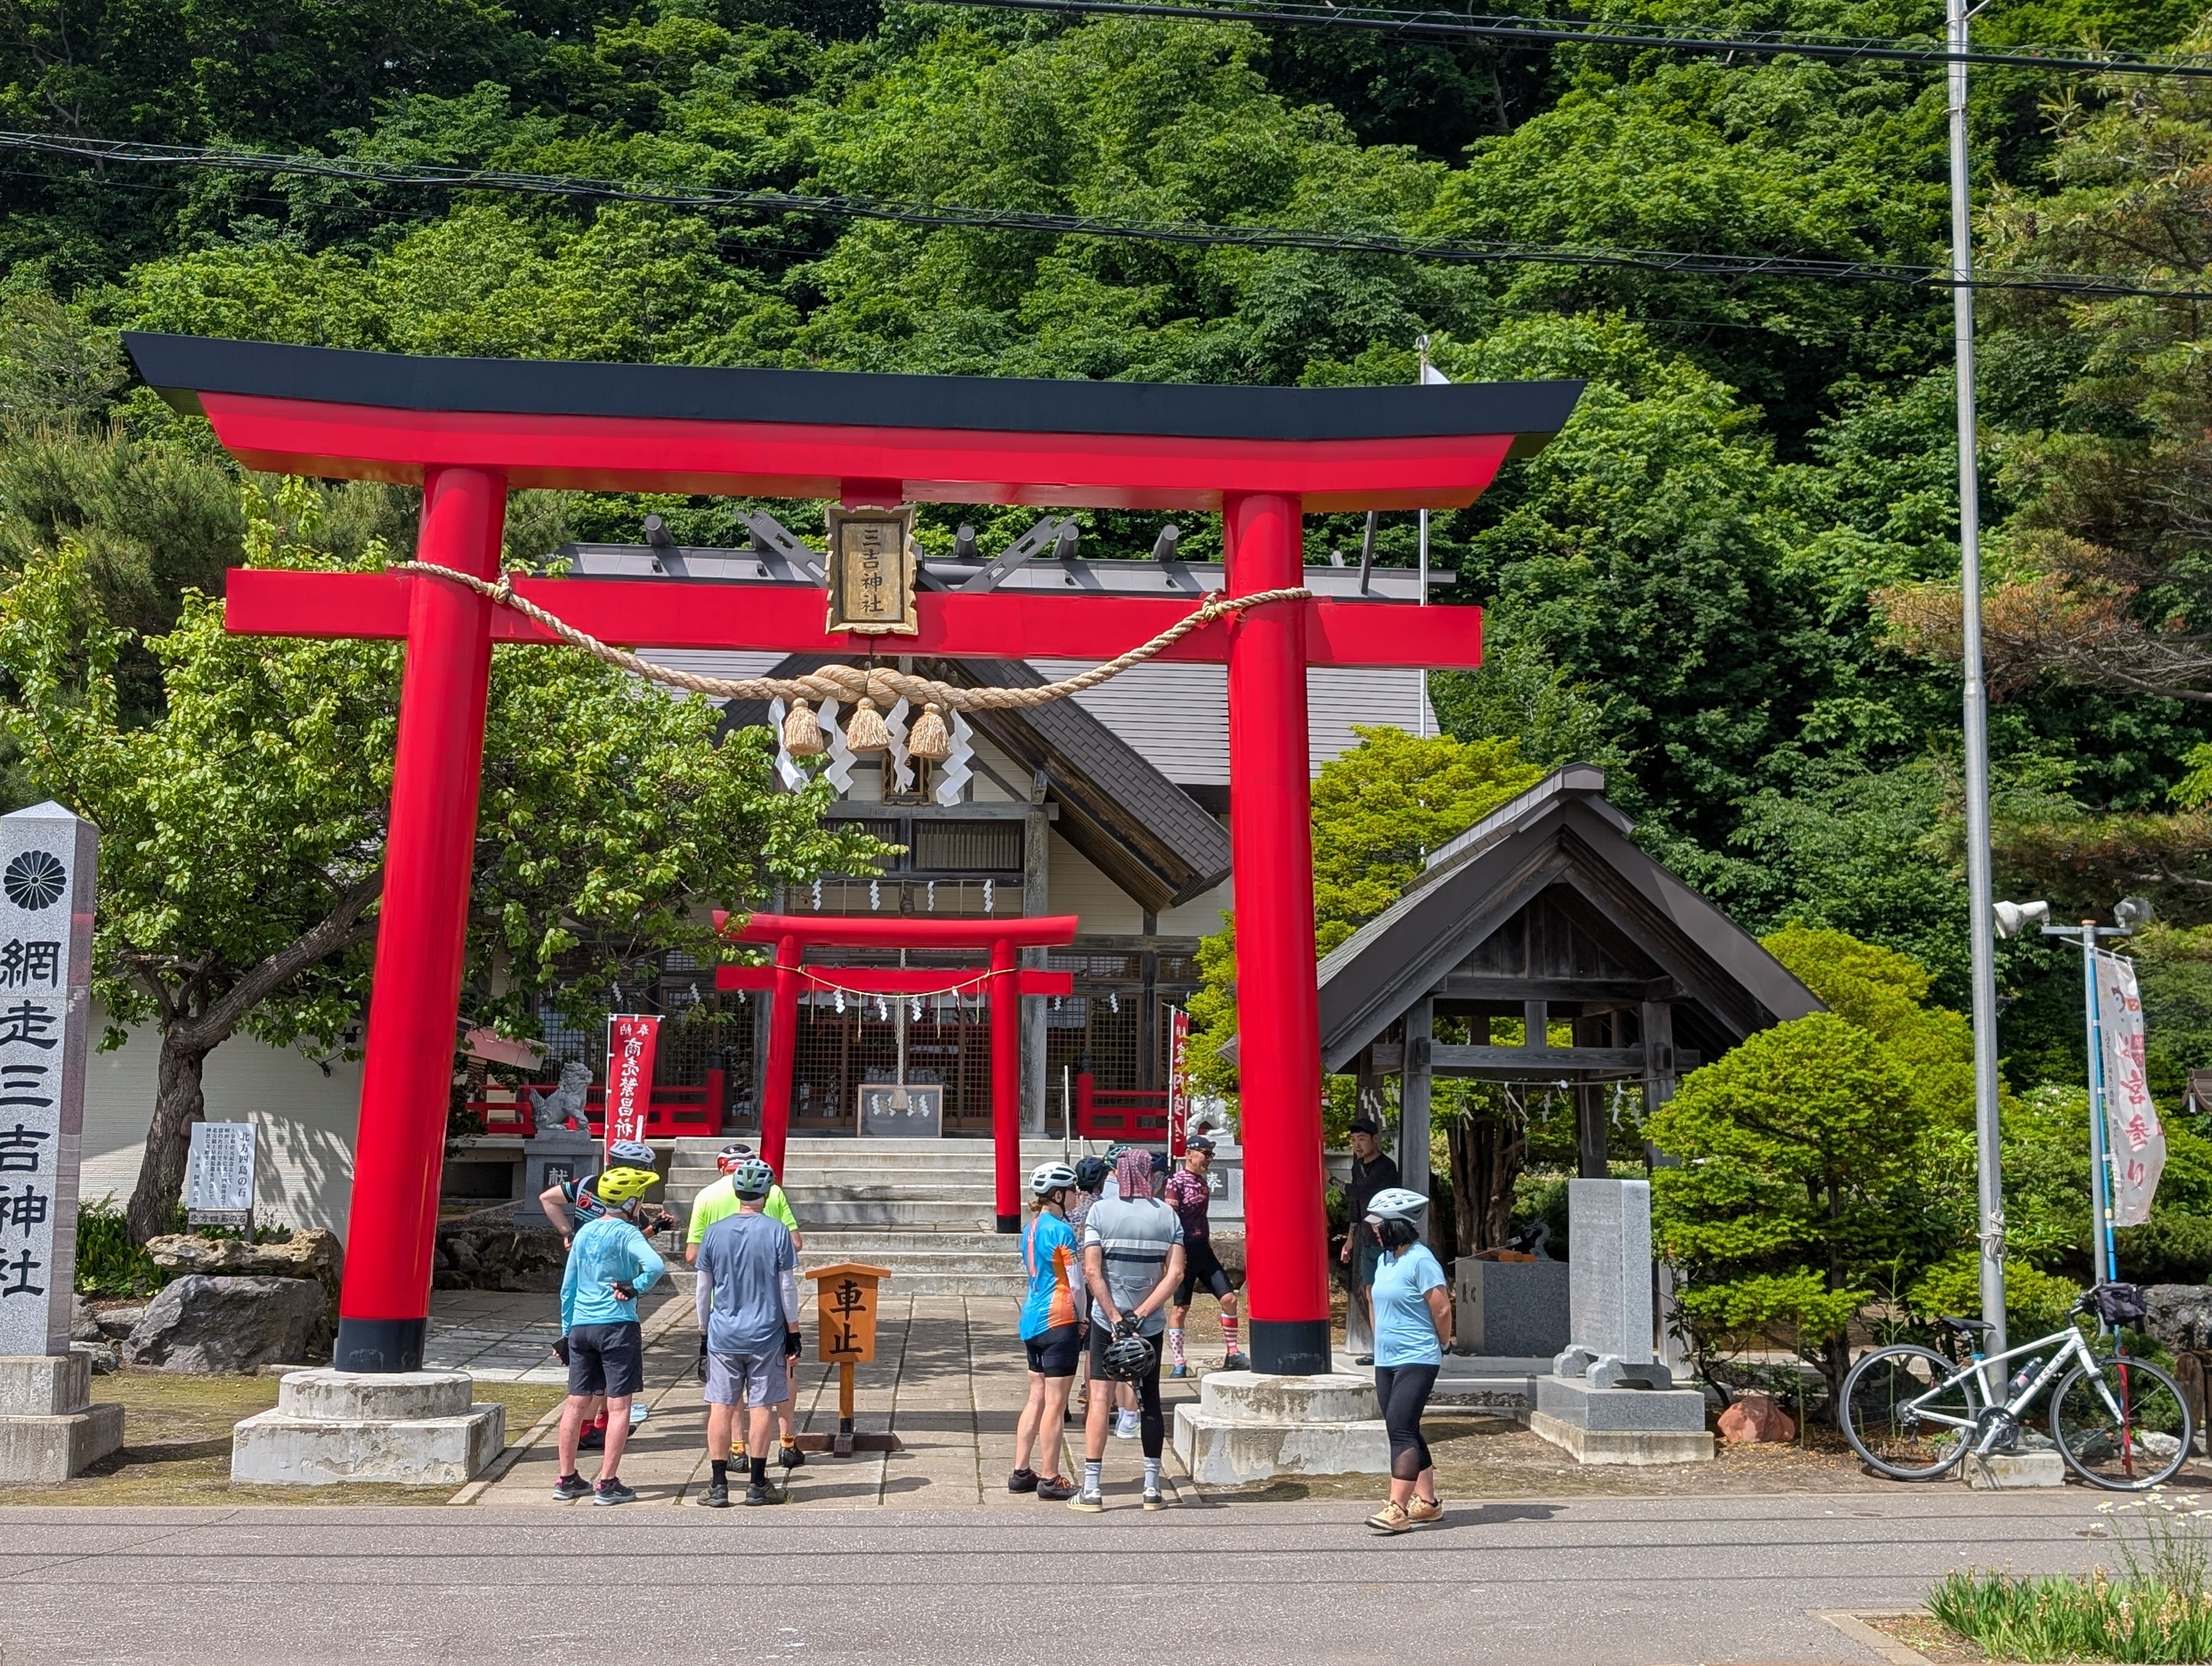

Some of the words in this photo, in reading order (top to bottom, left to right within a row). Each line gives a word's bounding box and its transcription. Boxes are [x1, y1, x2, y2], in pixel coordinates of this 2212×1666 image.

[861, 529, 884, 613] 三吉神社
[0, 938, 61, 1298] 網走三吉神社
[237, 1132, 249, 1197] 北方四島の石
[548, 1167, 568, 1186] 献
[1206, 1171, 1223, 1193] 奉
[190, 1214, 246, 1223] 北方四島の石
[829, 1279, 867, 1355] 車止
